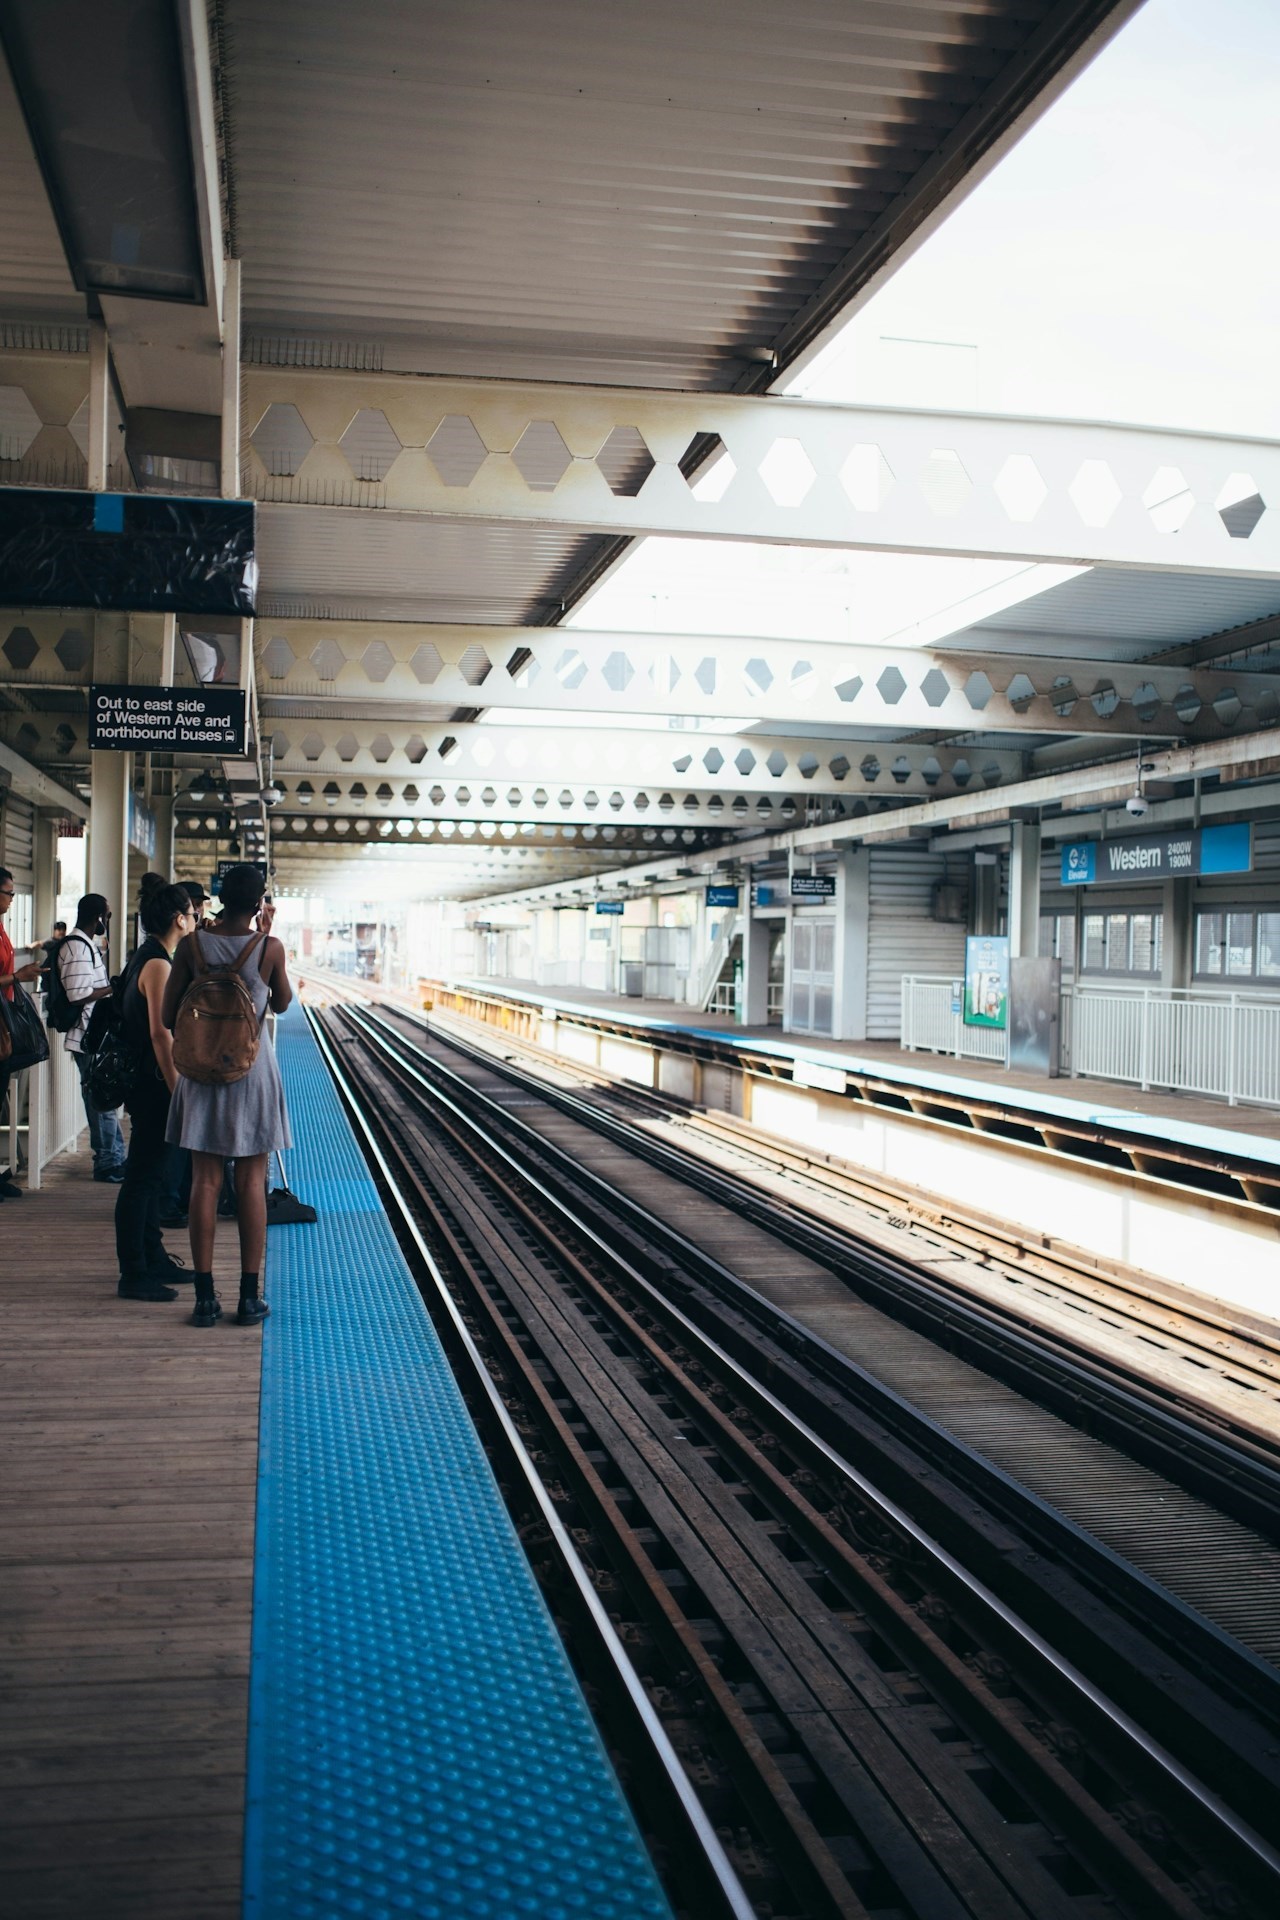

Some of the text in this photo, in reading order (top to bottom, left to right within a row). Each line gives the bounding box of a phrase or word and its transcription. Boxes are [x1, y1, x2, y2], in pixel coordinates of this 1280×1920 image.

[97, 696, 206, 713] Out to east side
[96, 710, 231, 728] of Western Ave and
[96, 726, 222, 742] northbound buses
[1109, 841, 1192, 870] Western 2400W
[1169, 854, 1192, 868] 1900N
